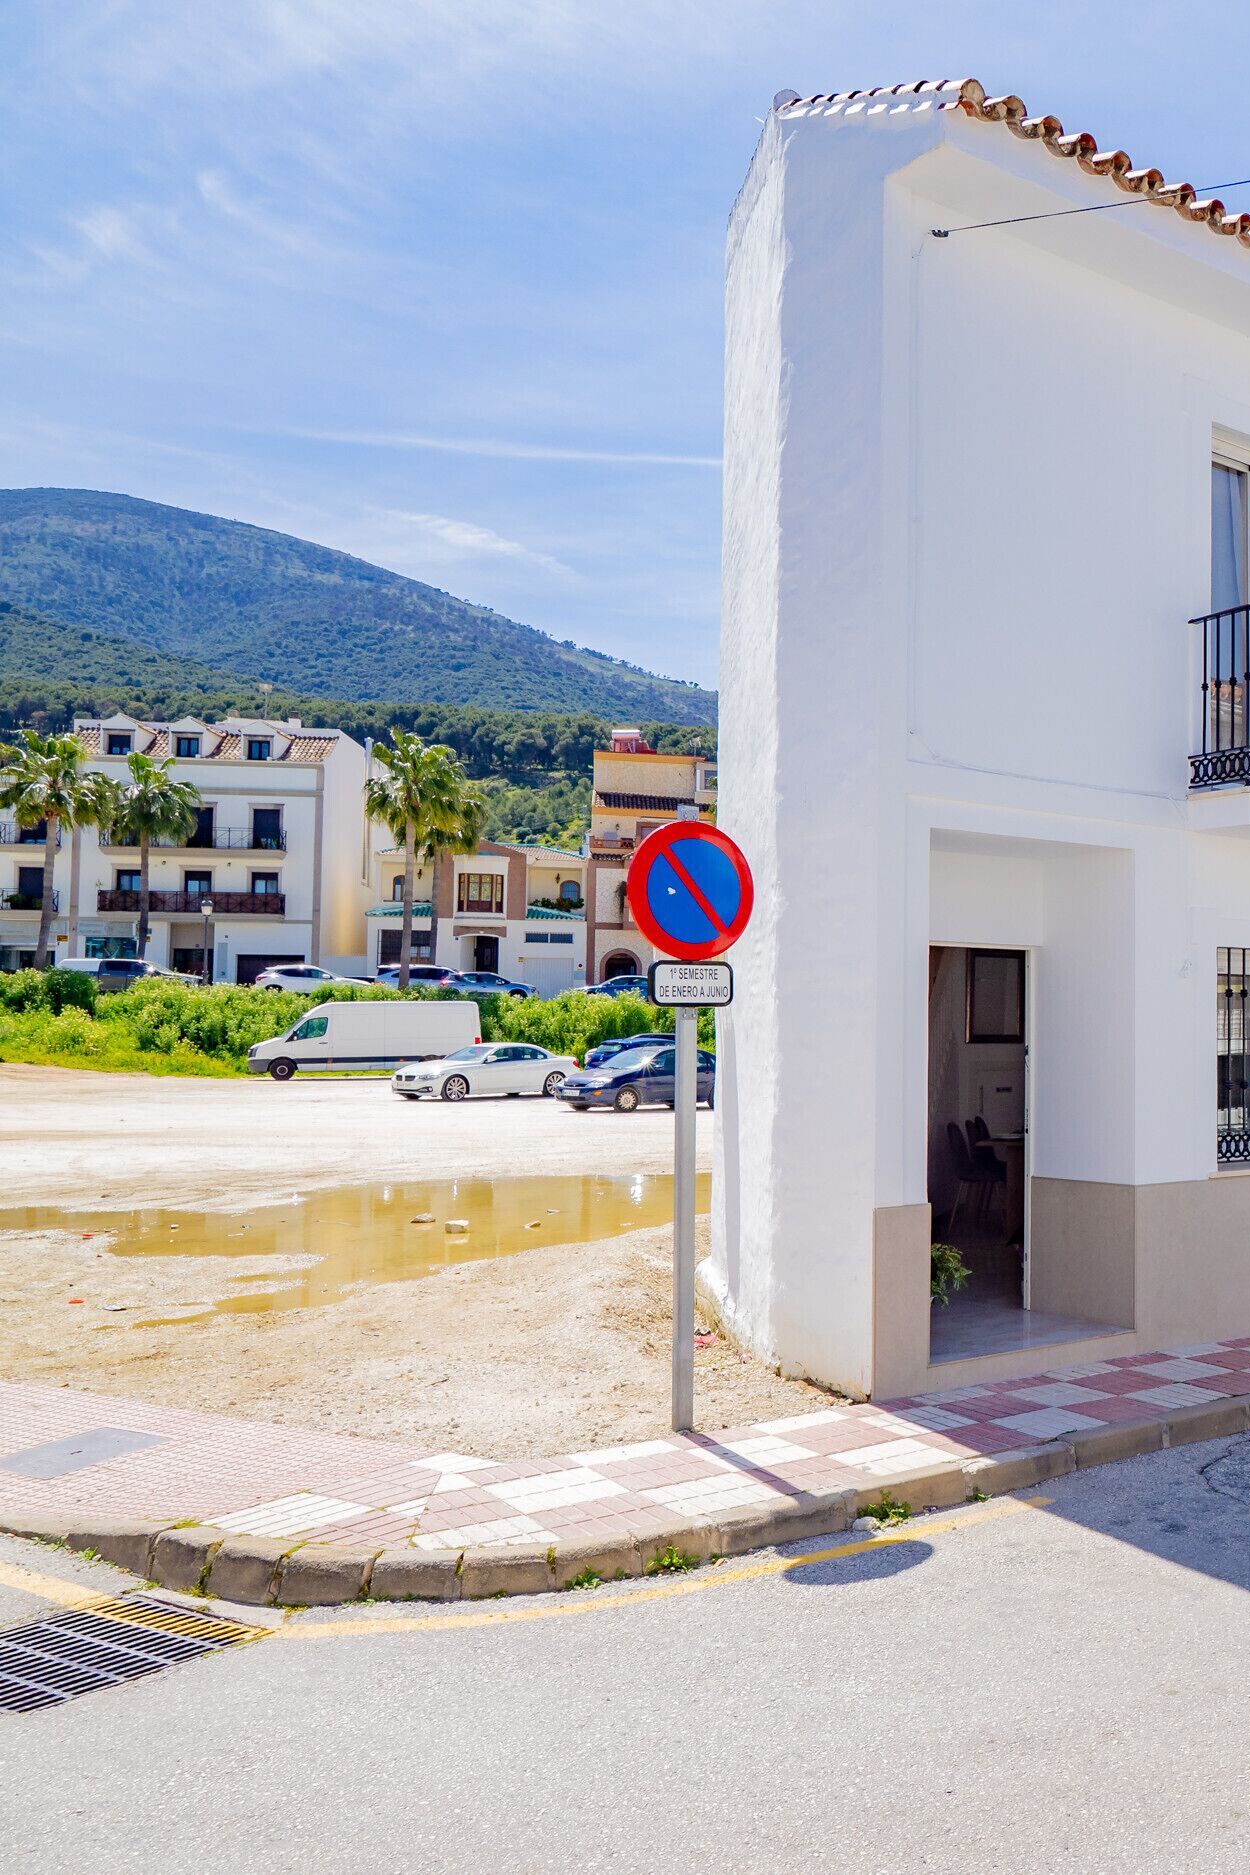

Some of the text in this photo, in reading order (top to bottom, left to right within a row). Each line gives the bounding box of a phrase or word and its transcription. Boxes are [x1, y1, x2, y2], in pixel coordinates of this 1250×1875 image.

[679, 968, 718, 980] SEMESTRE
[659, 985, 729, 997] DE ENERO A JUNIO
